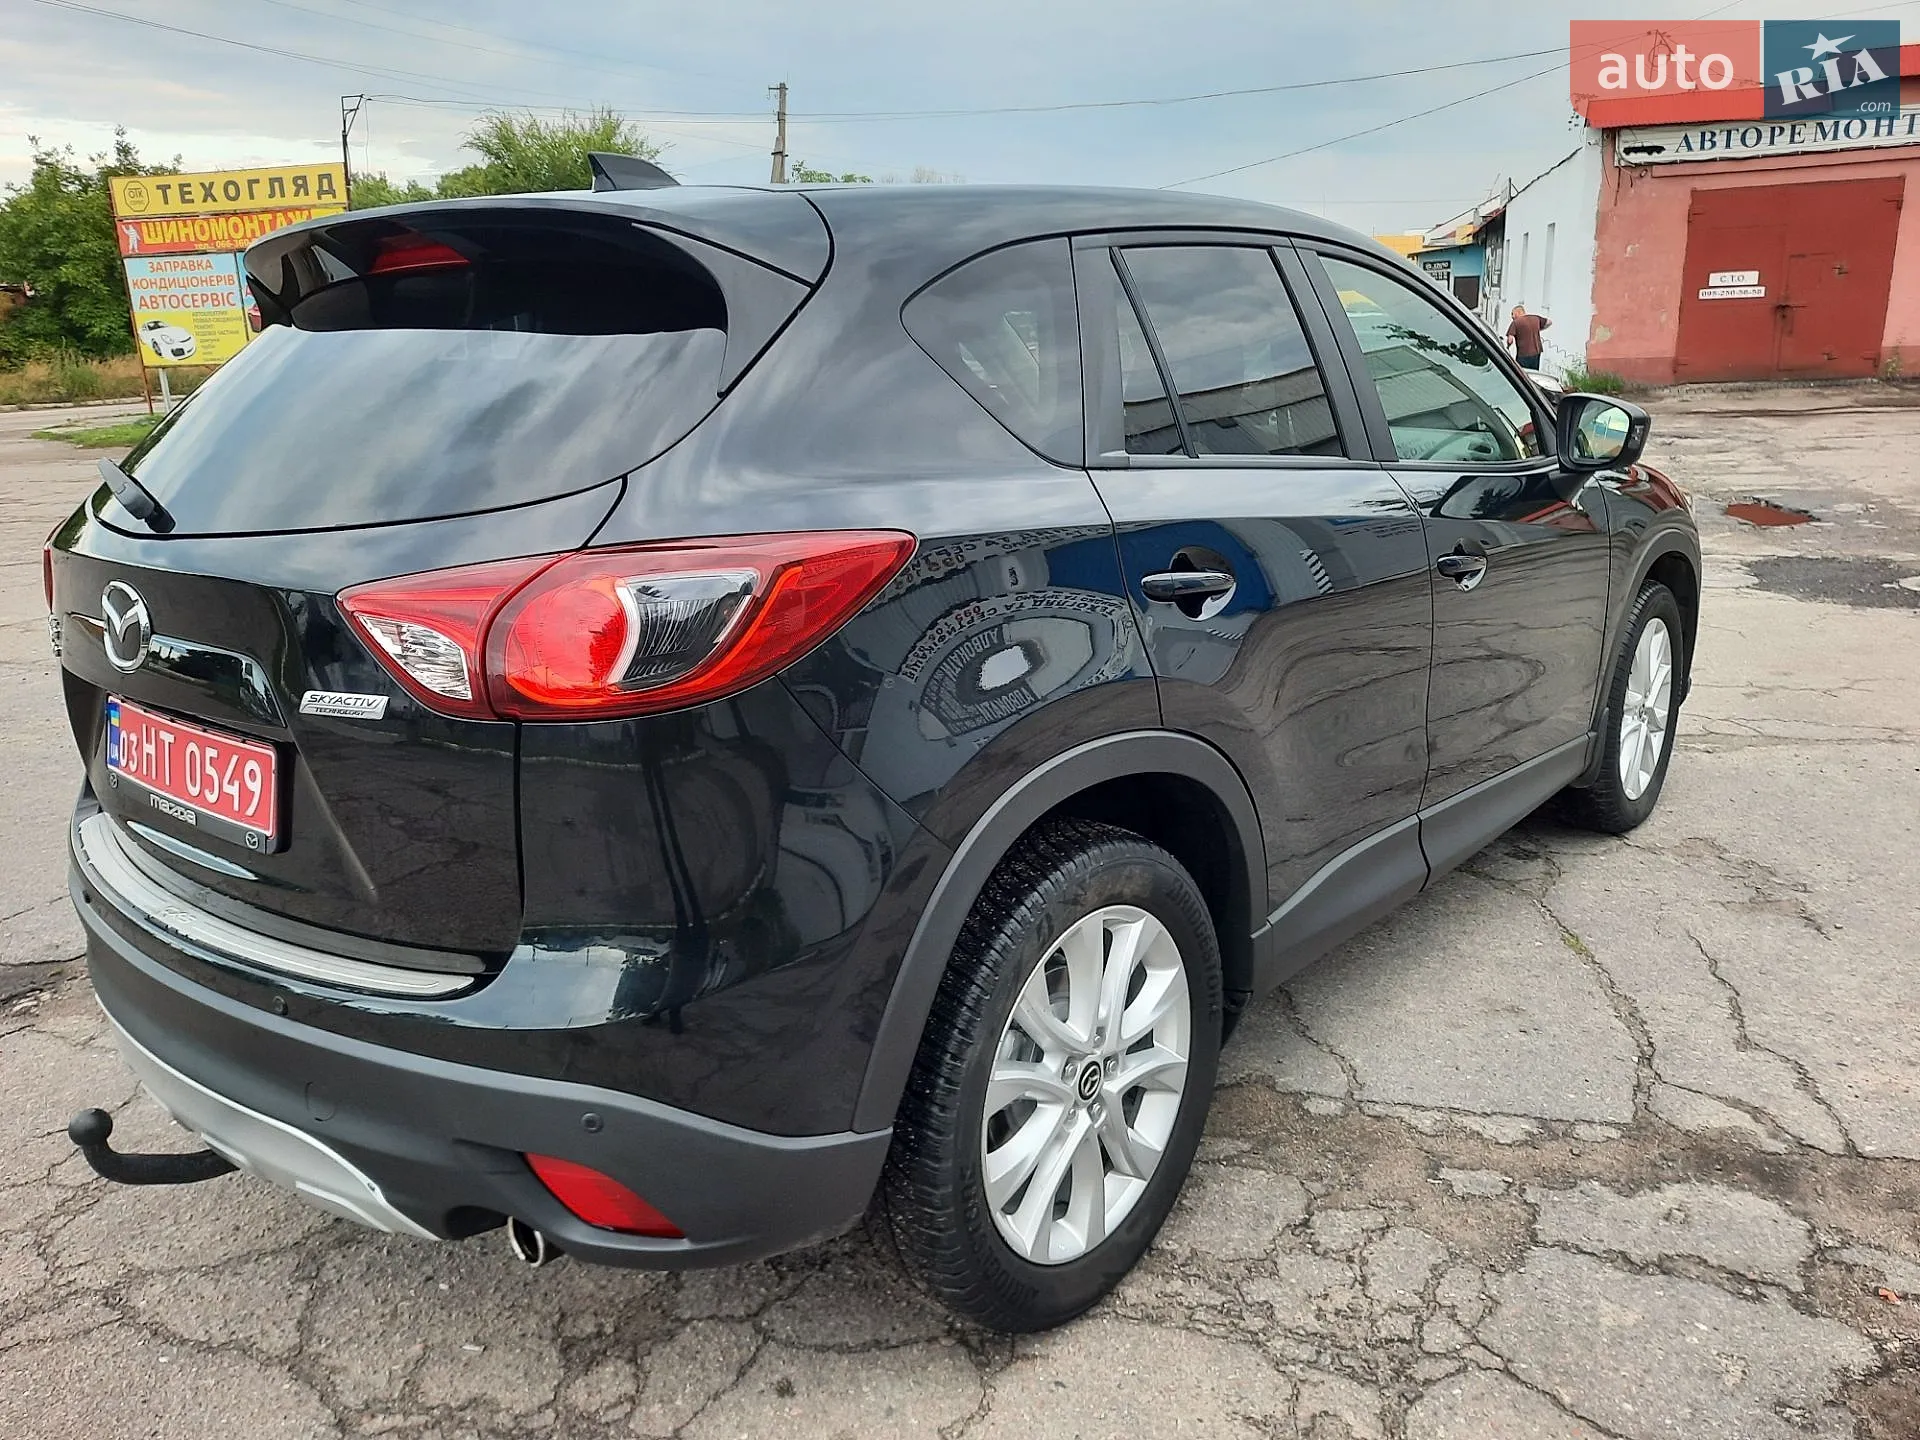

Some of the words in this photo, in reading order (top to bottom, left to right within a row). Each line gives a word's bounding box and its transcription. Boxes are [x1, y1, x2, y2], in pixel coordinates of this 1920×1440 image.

[1675, 113, 1919, 152] АВТОРЕМОНТ
[156, 173, 336, 205] ТЕХОГЛЯД
[141, 208, 311, 244] ШИНОМОНТАЖ
[148, 258, 213, 273] ЗАПРАВКА
[132, 275, 235, 291] КОНДИЦІОНЕРІВ
[138, 292, 236, 310] АВТОСЕРВІС
[307, 694, 377, 708] SKYACTIV
[185, 745, 265, 817] 0549
